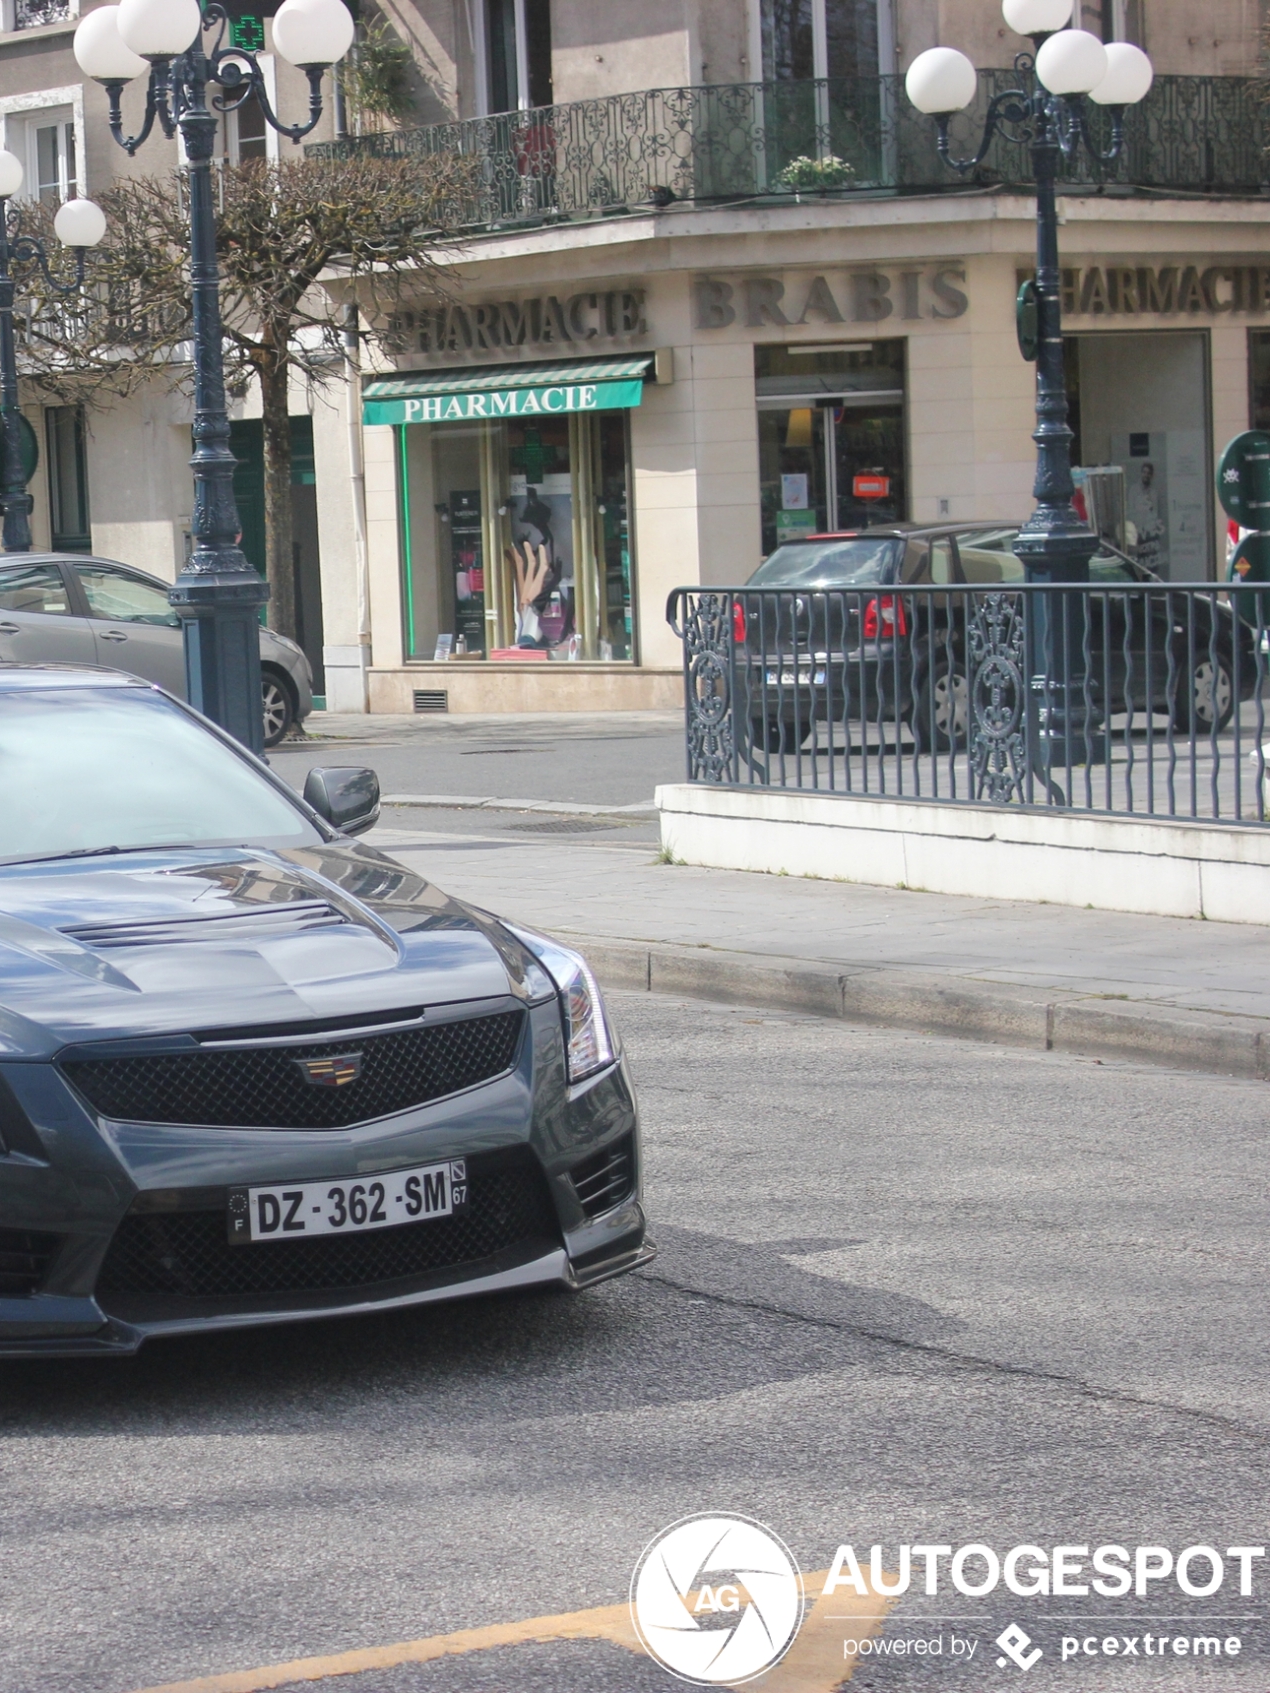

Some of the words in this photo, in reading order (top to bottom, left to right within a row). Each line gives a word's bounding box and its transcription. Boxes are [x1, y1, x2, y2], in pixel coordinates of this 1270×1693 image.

[694, 269, 969, 330] BRABIS
[403, 384, 598, 422] PHARMACIE
[452, 1185, 467, 1205] 67
[234, 1219, 244, 1231] F
